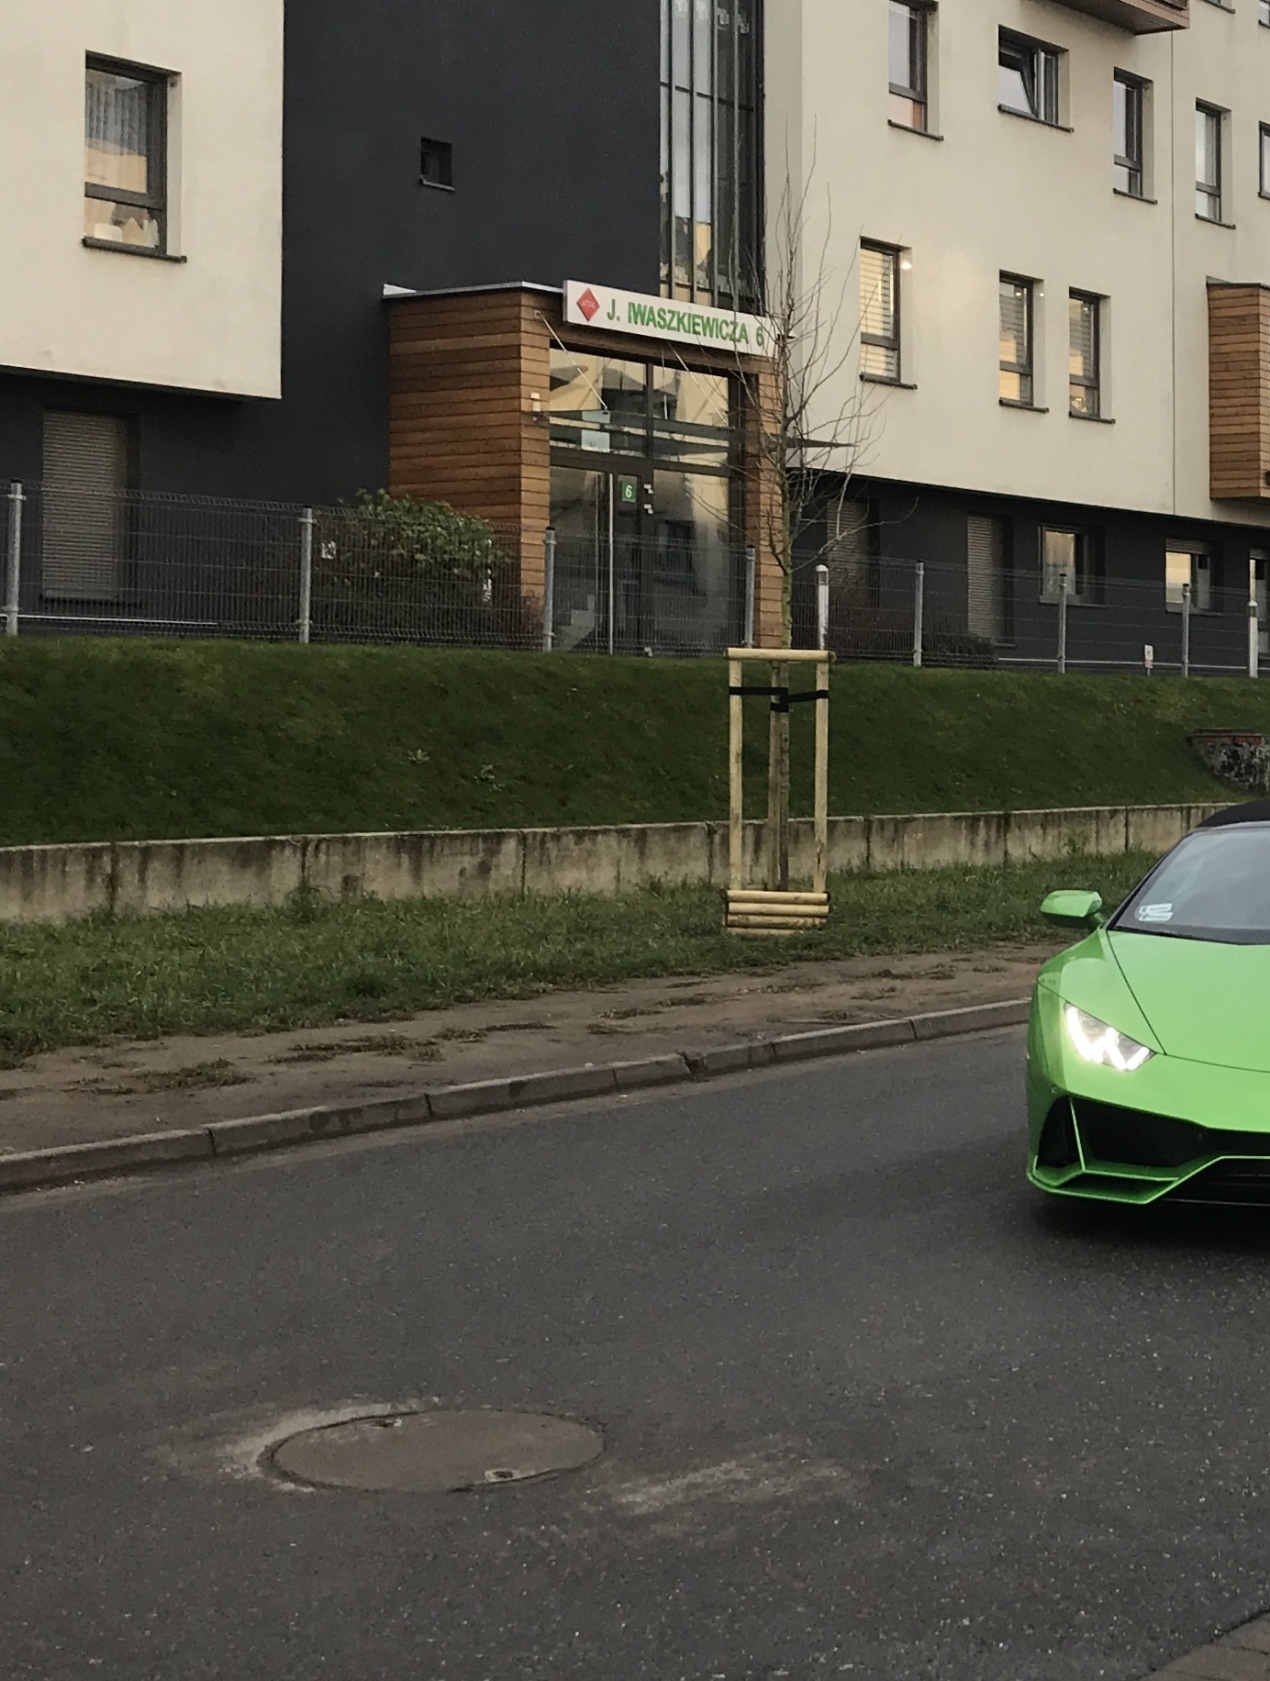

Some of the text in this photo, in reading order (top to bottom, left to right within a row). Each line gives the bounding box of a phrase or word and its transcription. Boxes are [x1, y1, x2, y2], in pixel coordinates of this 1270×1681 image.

[606, 298, 620, 322] J.
[627, 301, 749, 345] IWASZKIEWICZA
[755, 325, 765, 347] 6
[625, 484, 633, 498] 6
